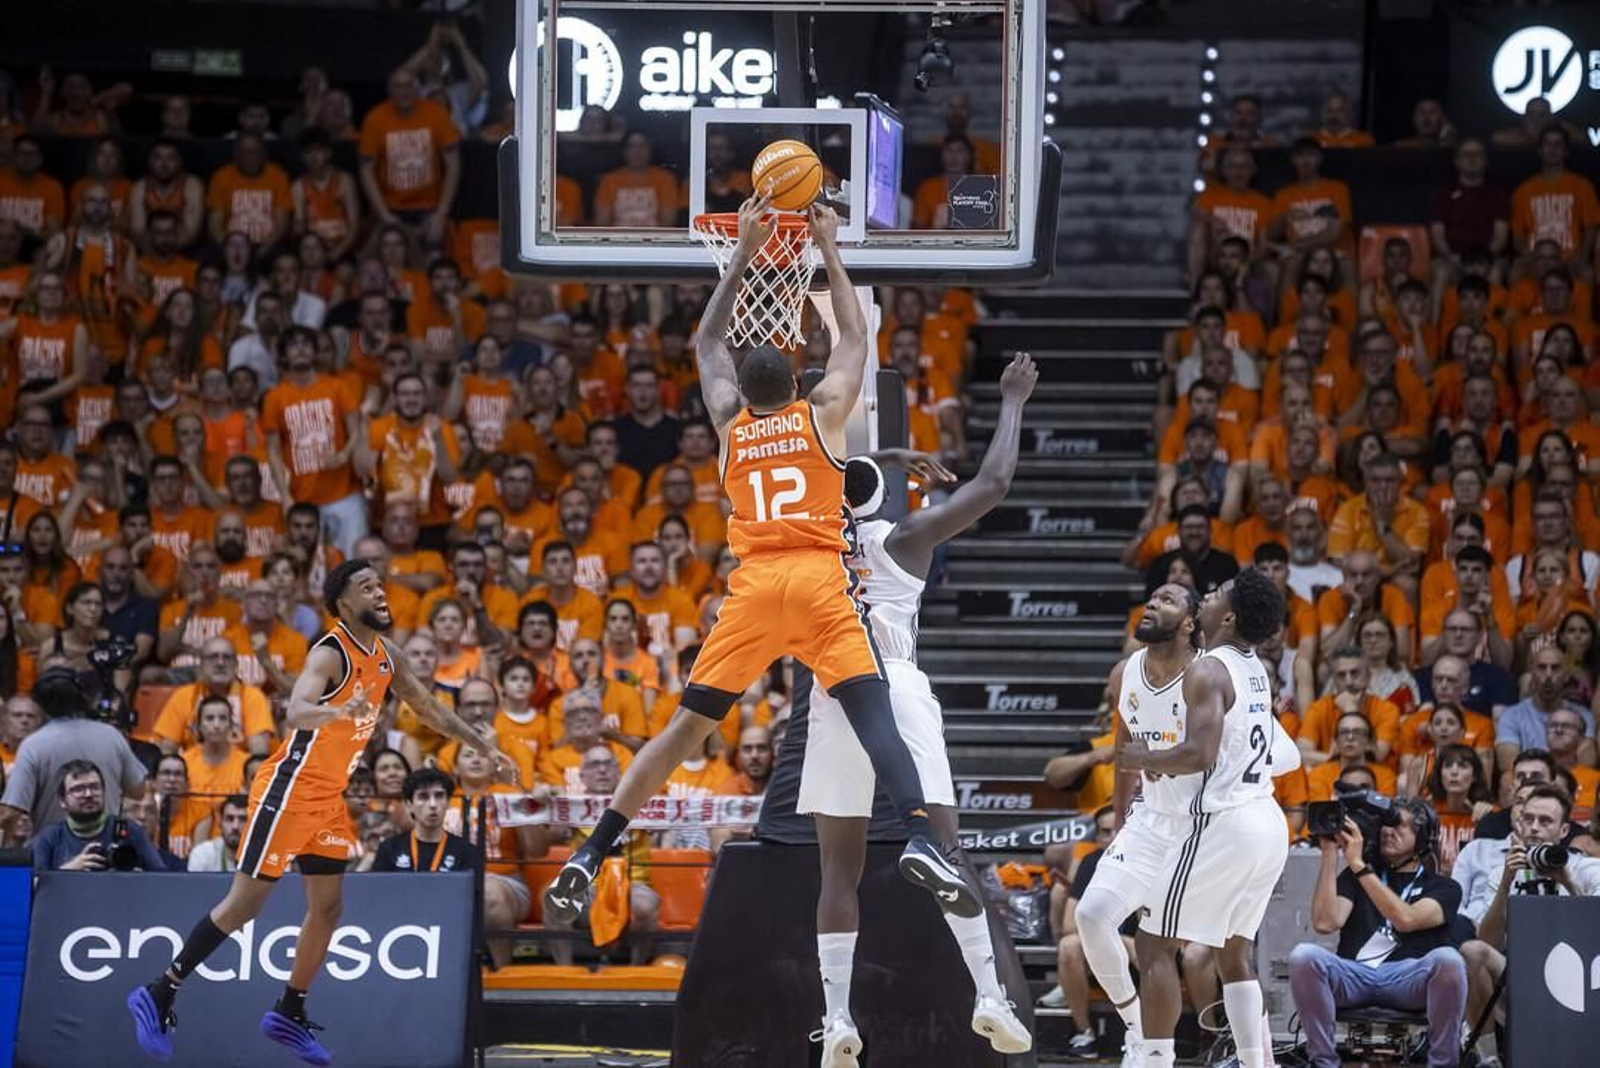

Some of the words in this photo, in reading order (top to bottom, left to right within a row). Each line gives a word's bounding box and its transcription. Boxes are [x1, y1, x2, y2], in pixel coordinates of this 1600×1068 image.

[640, 30, 774, 96] aike
[1503, 40, 1576, 95] JV
[755, 147, 796, 175] Wilson
[734, 412, 804, 443] SORIANO
[1034, 429, 1099, 454] Torres
[736, 438, 810, 463] PAMESA
[748, 466, 810, 523] 12
[1027, 508, 1096, 533] Torres
[1008, 591, 1079, 617] Torres
[984, 684, 1059, 711] Torres
[956, 781, 1033, 809] Torres
[959, 832, 1021, 850] sket
[1029, 820, 1087, 845] club
[59, 917, 441, 982] endesa
